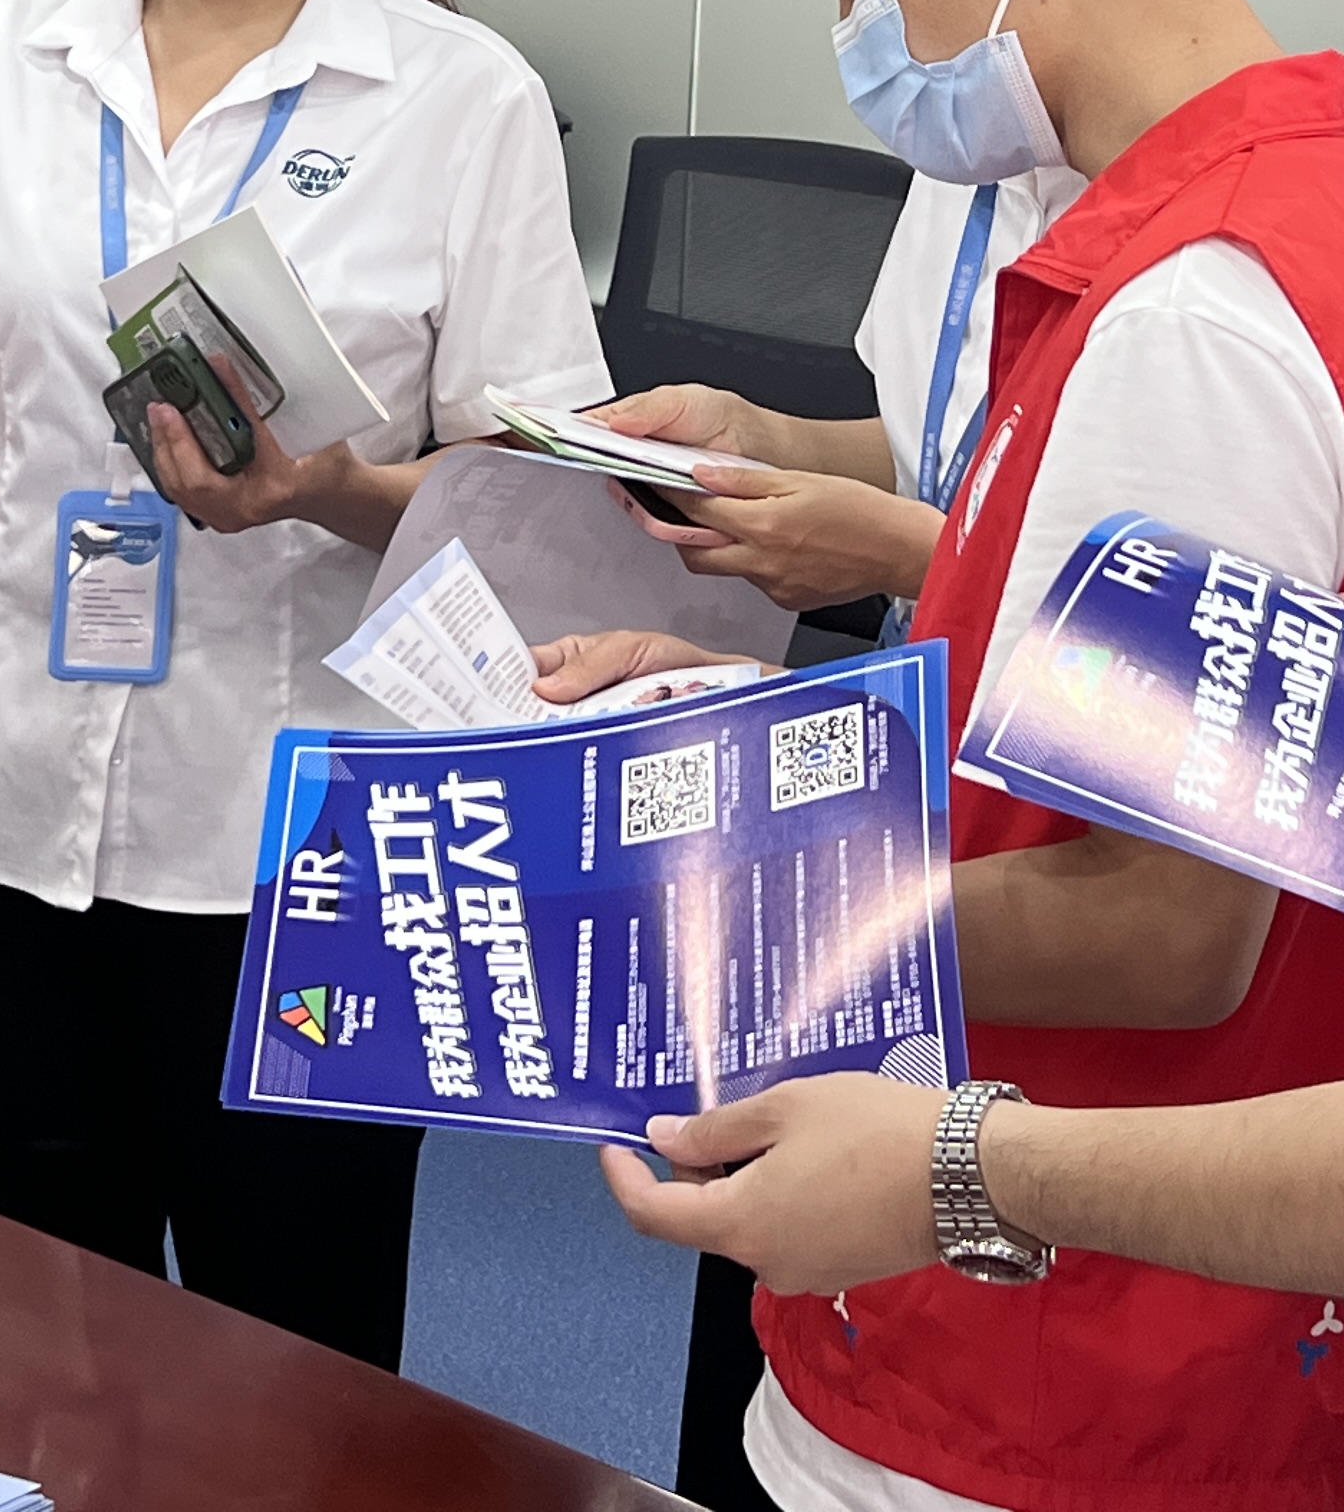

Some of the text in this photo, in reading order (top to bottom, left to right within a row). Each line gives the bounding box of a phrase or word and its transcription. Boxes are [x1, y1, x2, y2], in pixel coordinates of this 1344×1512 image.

[281, 160, 351, 181] DERUN
[1102, 538, 1178, 593] HR
[287, 849, 345, 922] HR
[367, 782, 482, 1099] 我为群众找工作
[437, 768, 558, 1099] 我为企业招人才
